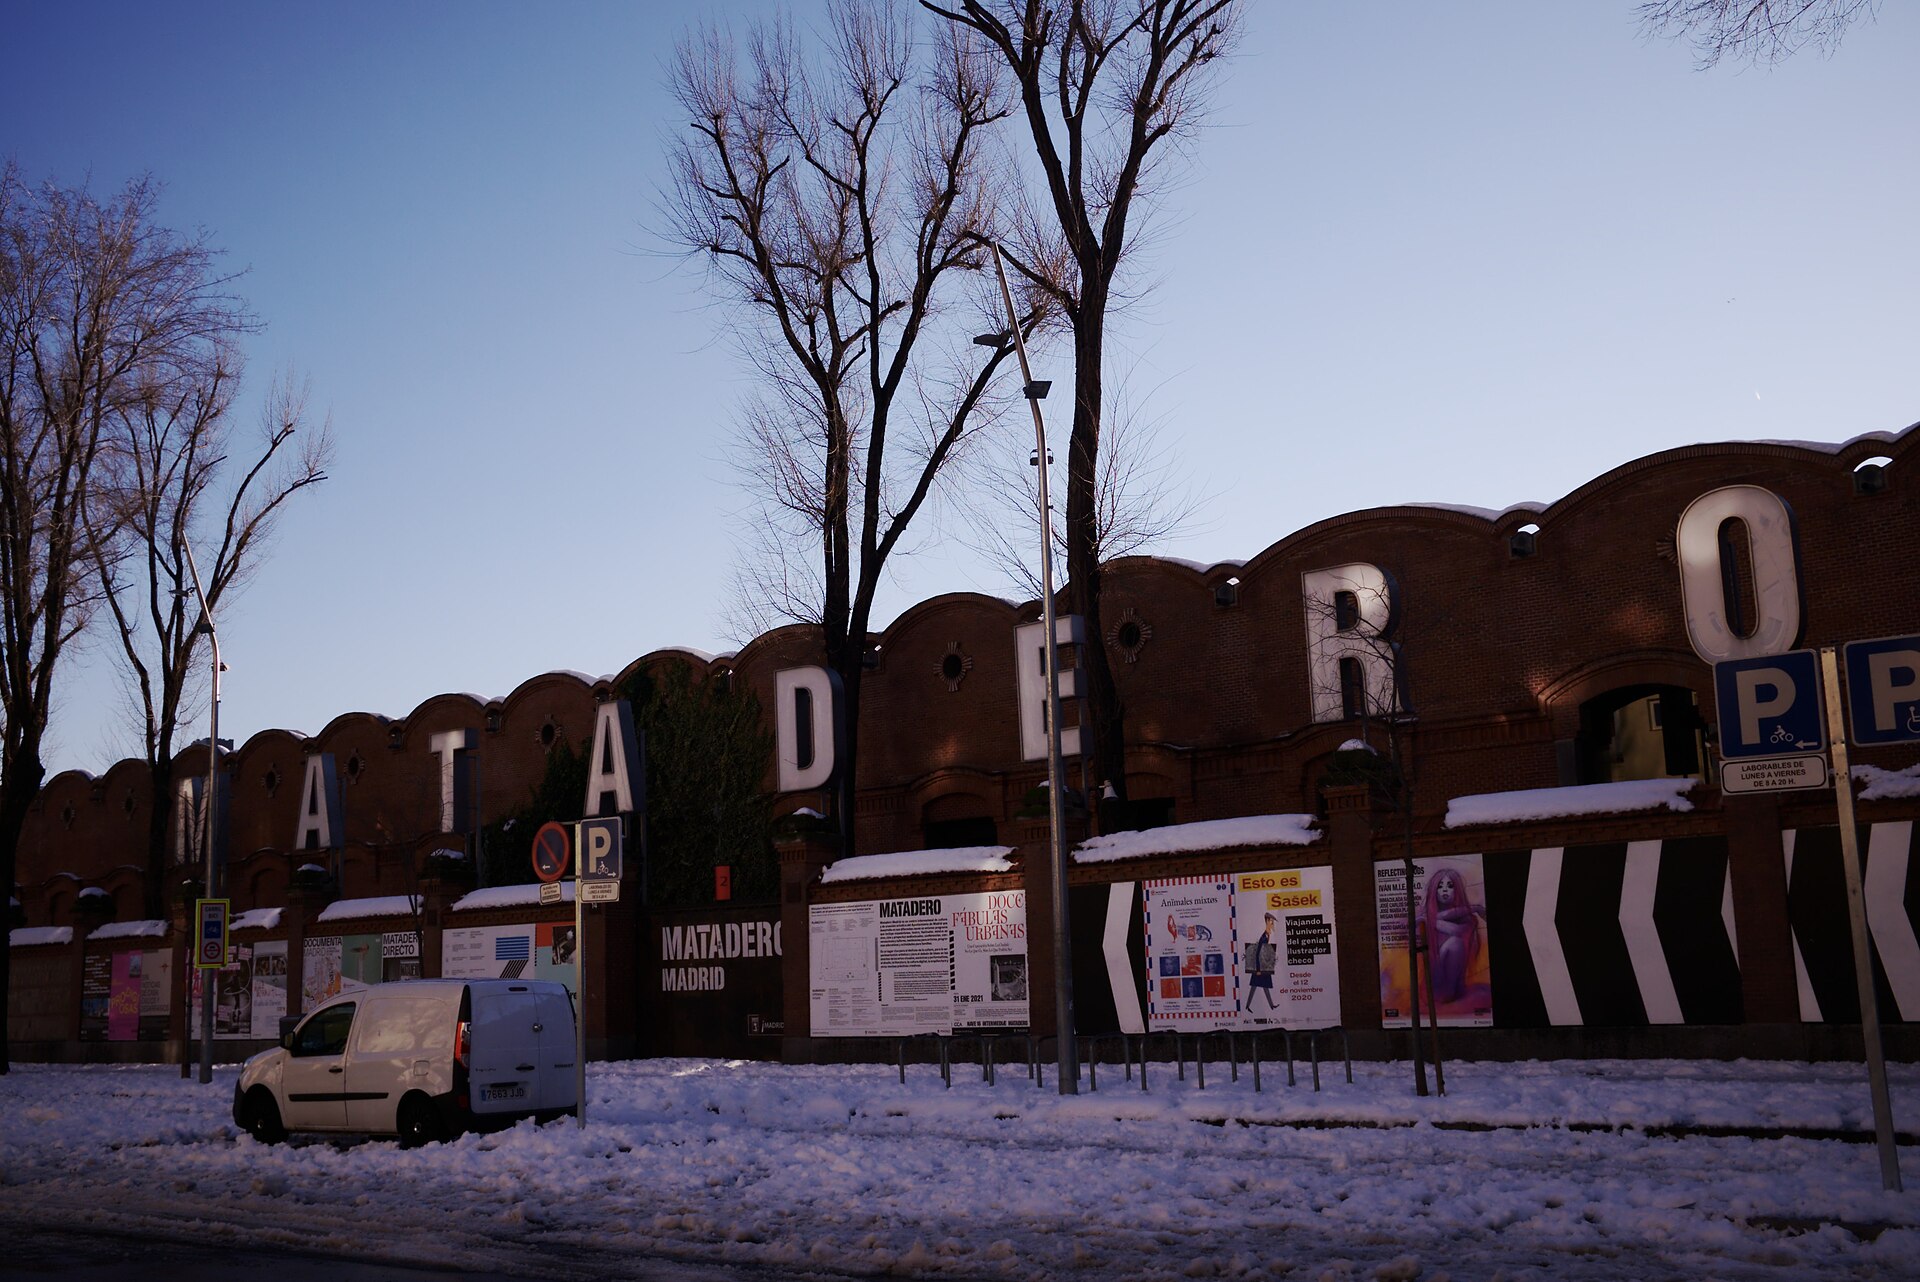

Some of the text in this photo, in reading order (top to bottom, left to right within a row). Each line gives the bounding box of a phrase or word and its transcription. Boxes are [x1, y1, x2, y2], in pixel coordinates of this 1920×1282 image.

[1736, 668, 1796, 745] P
[1742, 762, 1792, 772] LABORABLES
[1741, 772, 1765, 780] LUNES
[1774, 769, 1806, 777] VIERNES
[589, 827, 611, 873] P
[1378, 868, 1408, 877] REFLECTIN
[720, 876, 728, 886] 2
[1242, 877, 1298, 889] Esto es
[1271, 893, 1318, 908] Šašek
[879, 899, 941, 918] MATADERO
[304, 937, 342, 947] DOCUMENTA
[383, 933, 418, 944] MATADER
[1301, 937, 1326, 946] genial
[383, 944, 415, 956] DIRECTO
[1288, 957, 1312, 965] checo
[662, 966, 725, 991] MADRID
[487, 1090, 507, 1099] 7663
